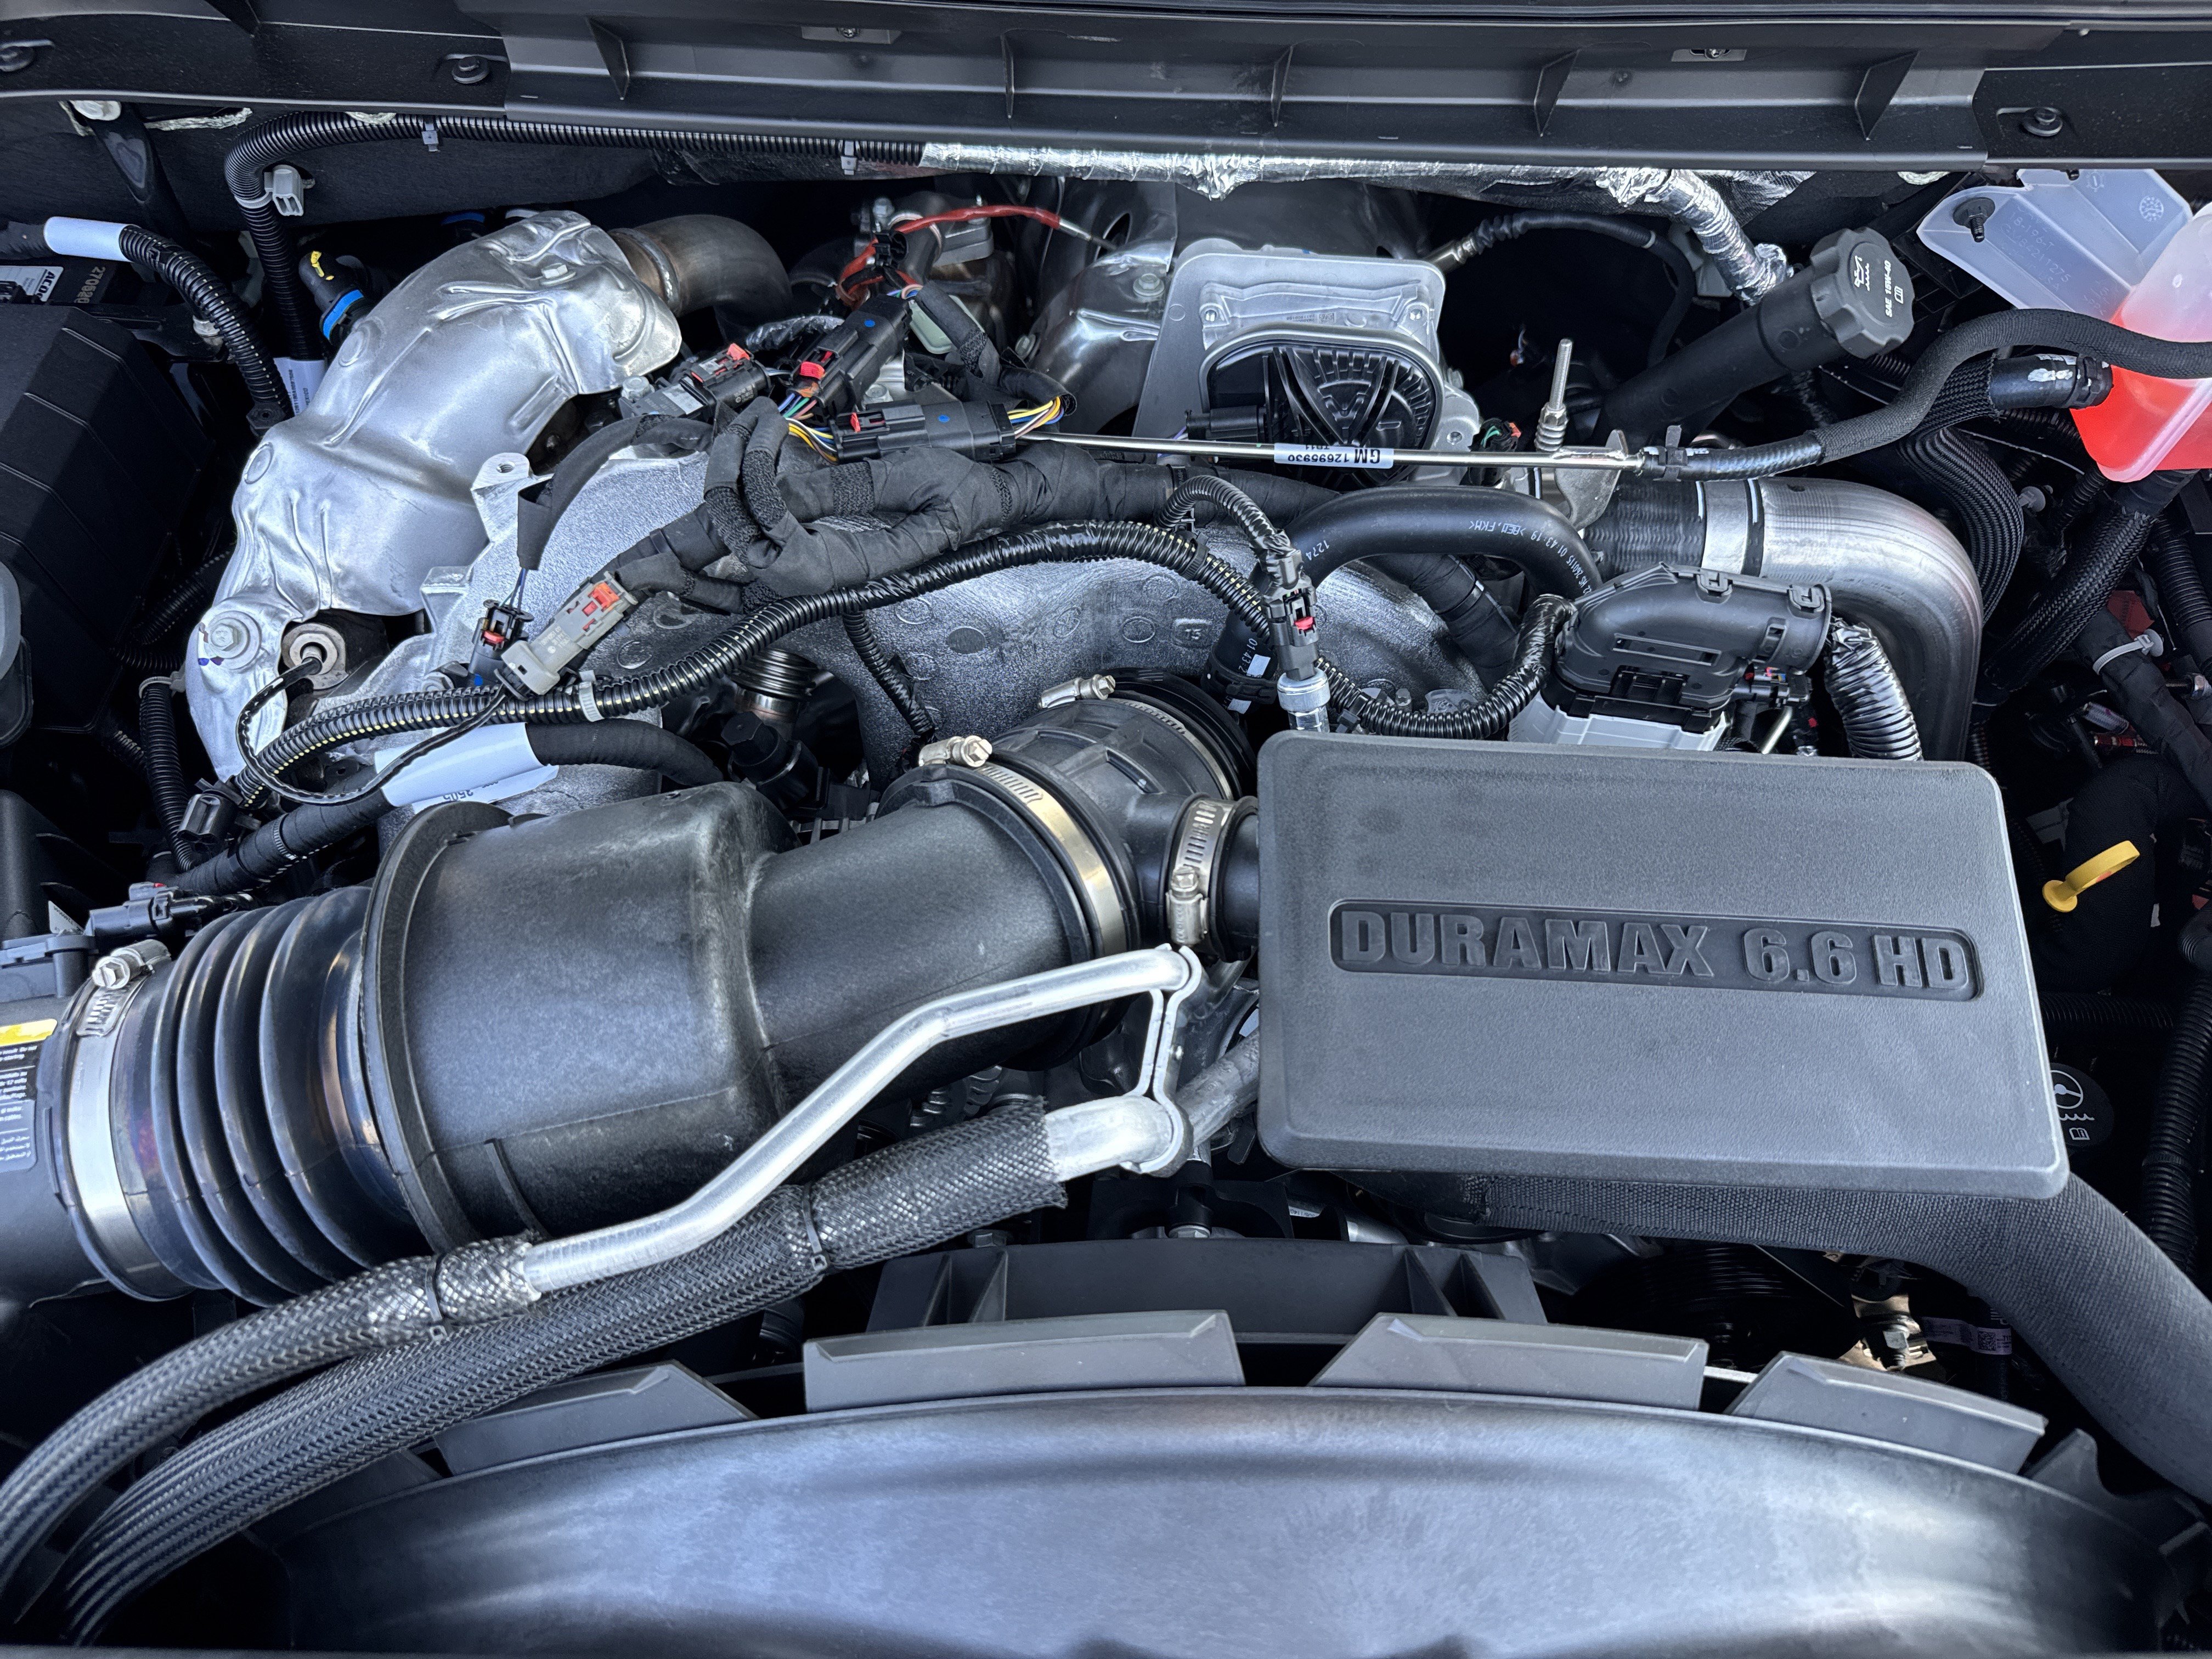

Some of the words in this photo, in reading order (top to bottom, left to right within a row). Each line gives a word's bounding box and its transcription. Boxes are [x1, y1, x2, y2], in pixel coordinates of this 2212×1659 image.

[1884, 260, 1892, 296] 15W-40
[1885, 299, 1893, 318] SAE
[1287, 455, 1349, 465] 12695930
[1353, 449, 1380, 464] GM
[1306, 539, 1330, 560] 1274
[1530, 530, 1568, 557] 01:43:19
[1565, 555, 1582, 579] 260115
[1578, 577, 1588, 588] HS
[1340, 911, 1714, 977] DURAMAX
[1743, 927, 1858, 985] 6.6
[1874, 934, 1970, 990] HD
